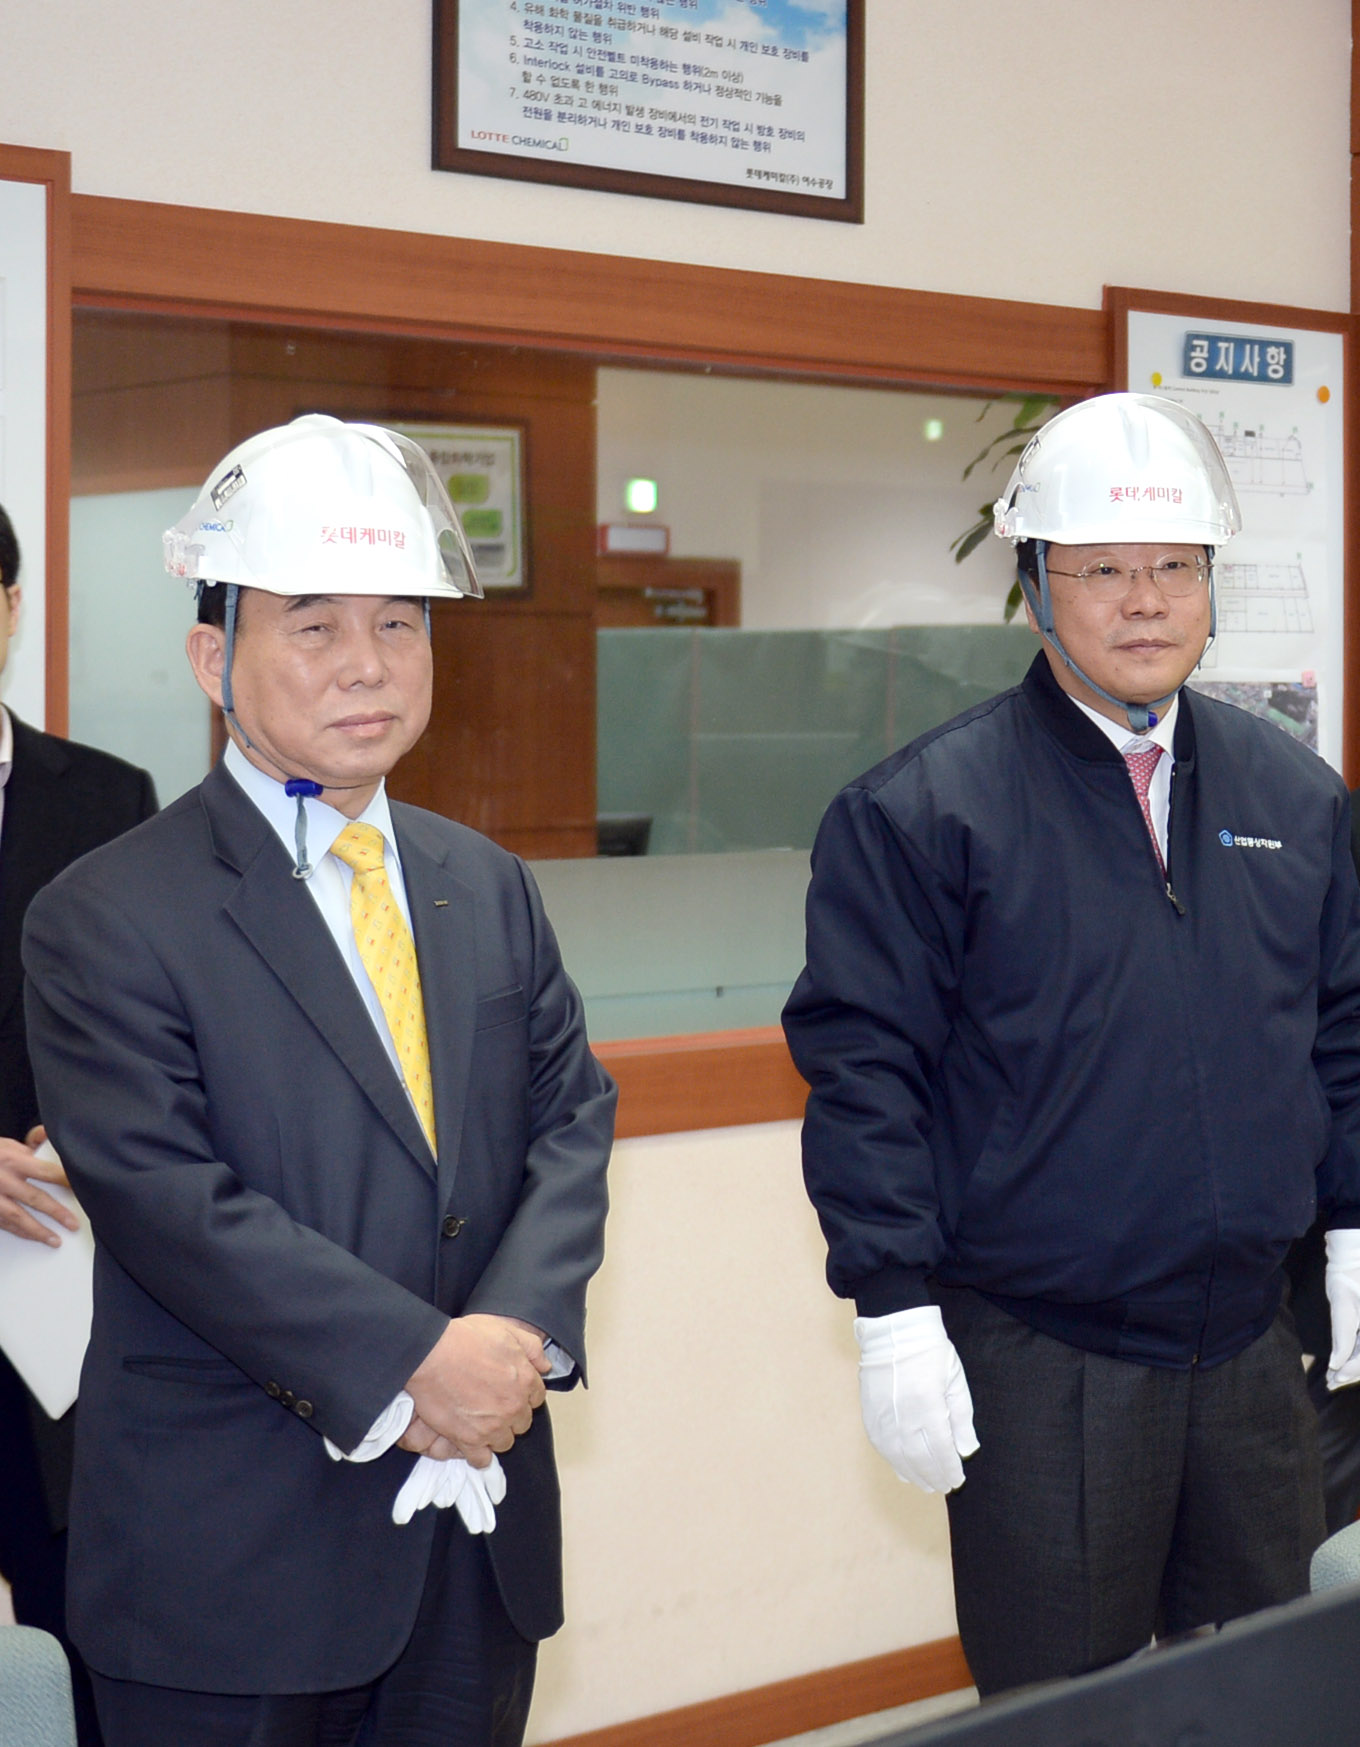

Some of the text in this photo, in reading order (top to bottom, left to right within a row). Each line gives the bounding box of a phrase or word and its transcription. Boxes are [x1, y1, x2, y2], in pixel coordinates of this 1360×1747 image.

[640, 5, 660, 20] 행위
[510, 1, 520, 13] 4.
[524, 2, 545, 17] 유해
[705, 34, 723, 48] 작업
[726, 38, 737, 50] 시
[740, 41, 758, 54] 개인
[761, 44, 780, 57] 보호
[782, 48, 809, 63] 장비를
[523, 19, 612, 45] 착용하지 않는 행위
[509, 35, 520, 47] 5.
[523, 37, 545, 51] 고소
[548, 41, 568, 55] 작업
[572, 45, 583, 57] 시
[509, 52, 520, 64] 6.
[523, 55, 570, 72] Interlock
[641, 73, 680, 90] Bypass
[683, 79, 711, 95] 하거나
[715, 85, 752, 101] 정상적인
[755, 91, 782, 107] 기능을
[550, 75, 580, 91] 없도록
[509, 86, 520, 99] 7.
[523, 89, 550, 103] 480V
[592, 99, 622, 114] 에너지
[700, 115, 719, 129] 전기
[722, 119, 741, 133] 작업
[471, 130, 564, 151] LOTTE CHEMICAL
[557, 111, 608, 130] 분리하거나
[611, 119, 631, 133] 개인
[634, 123, 655, 137] 보호
[658, 126, 686, 141] 장비를
[690, 130, 728, 147] 착용하지
[731, 136, 751, 151] 않는
[753, 140, 772, 154] 행위
[1190, 338, 1287, 380] 공지사항
[321, 527, 405, 549] 롯데케미칼
